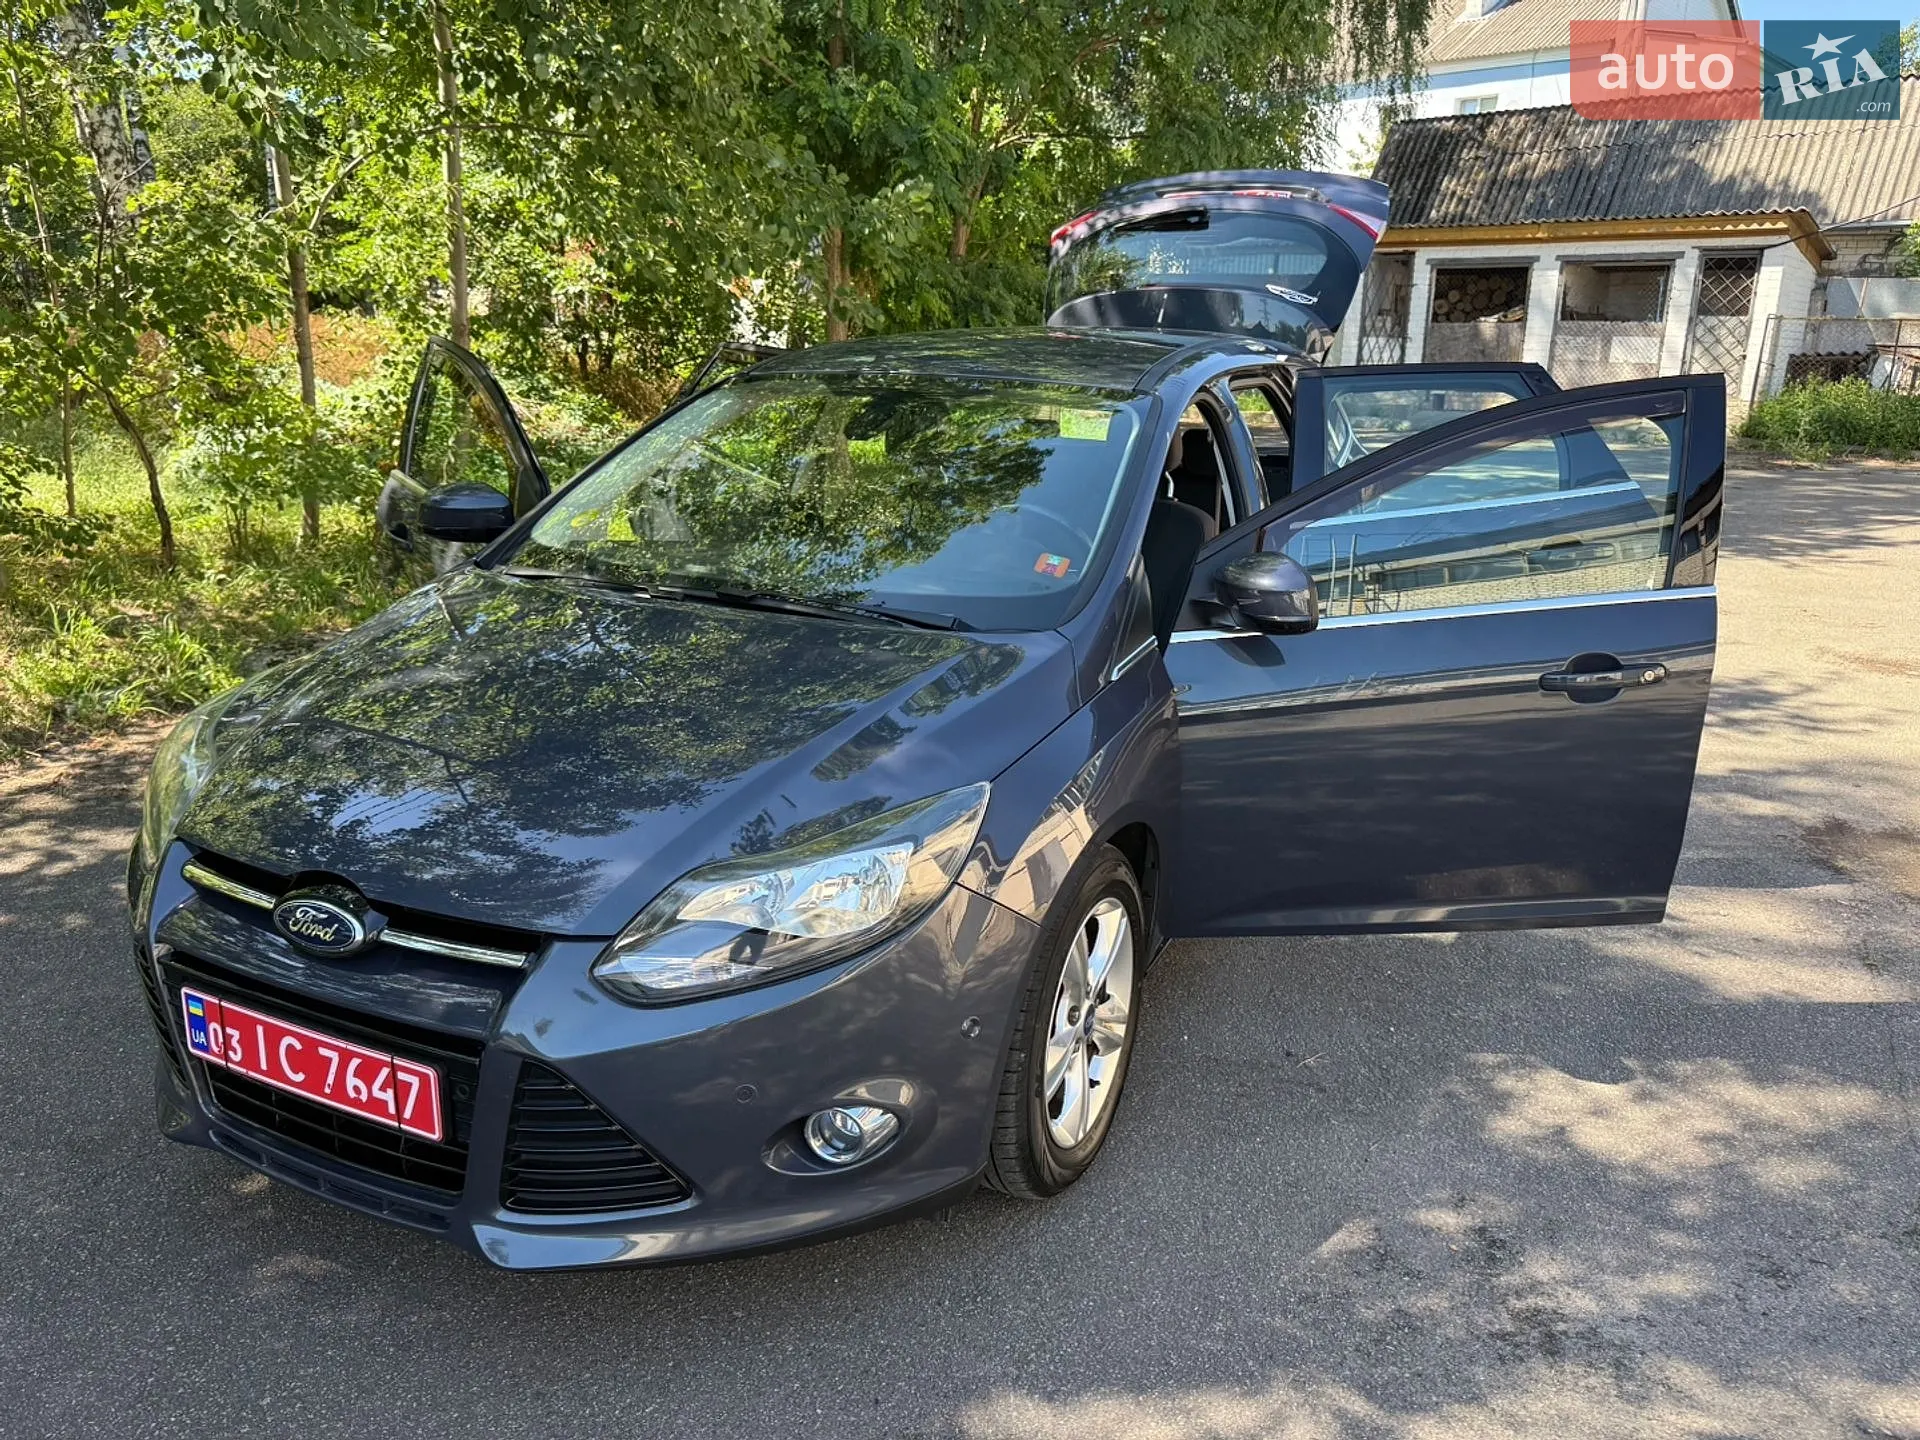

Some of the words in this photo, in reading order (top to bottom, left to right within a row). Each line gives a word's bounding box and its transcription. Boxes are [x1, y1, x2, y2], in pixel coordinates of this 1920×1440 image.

[289, 906, 338, 941] Ford
[191, 1028, 207, 1046] UA
[318, 1046, 420, 1120] 7647
